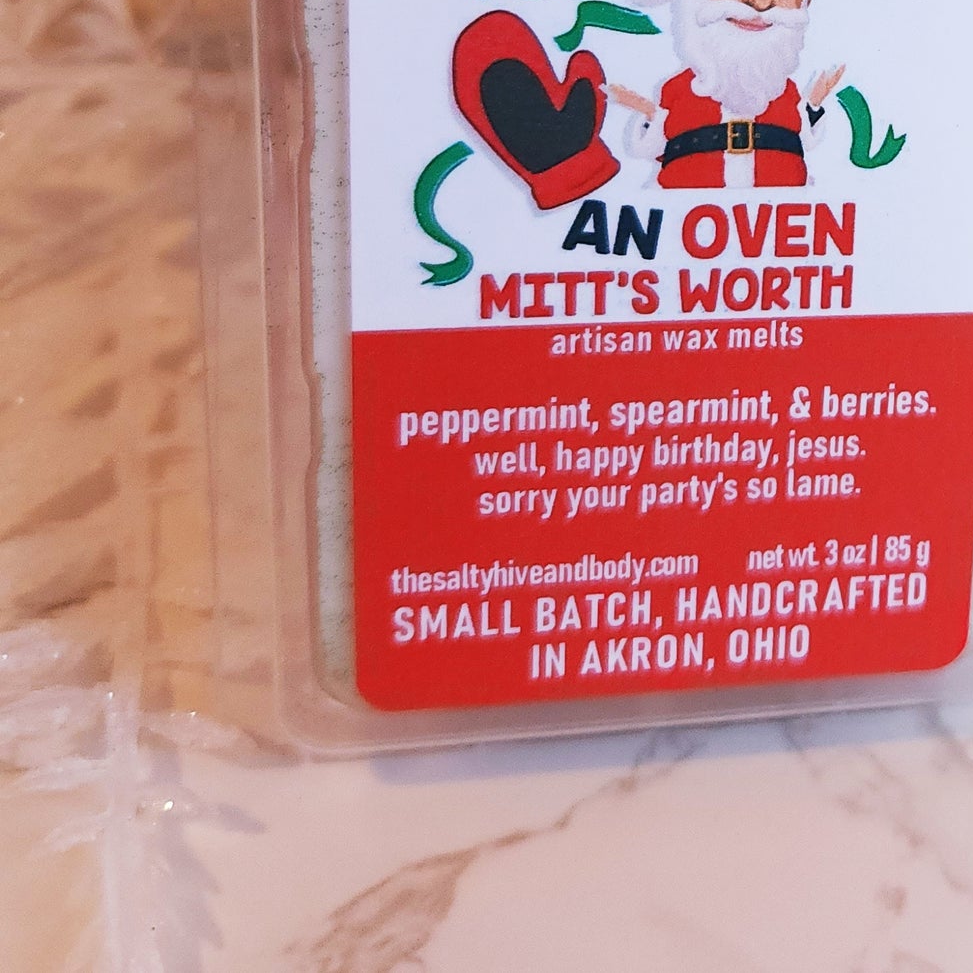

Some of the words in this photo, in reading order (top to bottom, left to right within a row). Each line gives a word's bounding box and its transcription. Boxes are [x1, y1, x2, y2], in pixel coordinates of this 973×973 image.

[561, 199, 663, 259] AN
[682, 203, 856, 259] OVEN
[479, 272, 660, 319] MITT'S
[679, 265, 853, 314] WORTH
[551, 324, 653, 356] artisan
[663, 329, 718, 351] wax
[728, 320, 804, 348] melts
[399, 397, 599, 446] peppermint,
[610, 391, 780, 434] spearmint,
[789, 386, 811, 420] &
[821, 383, 936, 416] berries.
[474, 446, 547, 477] well,
[555, 443, 643, 476] happy
[653, 435, 779, 469] birthday,
[786, 433, 866, 465] jesus.
[479, 486, 554, 520] sorry
[566, 485, 629, 517] your
[640, 472, 737, 512] party's
[747, 477, 777, 499] so
[786, 469, 861, 498] lame.
[390, 552, 698, 596] thesaltyhiveandbody.com
[747, 546, 783, 570] net
[824, 542, 838, 565] 3
[885, 537, 910, 562] 85
[916, 540, 930, 567] g
[393, 602, 520, 643] SMALL
[535, 591, 663, 632] BATCH,
[676, 572, 928, 622] HANDCRAFTED
[530, 643, 565, 679] IN
[581, 632, 716, 674] AKRON,
[728, 625, 810, 663] OHIO
